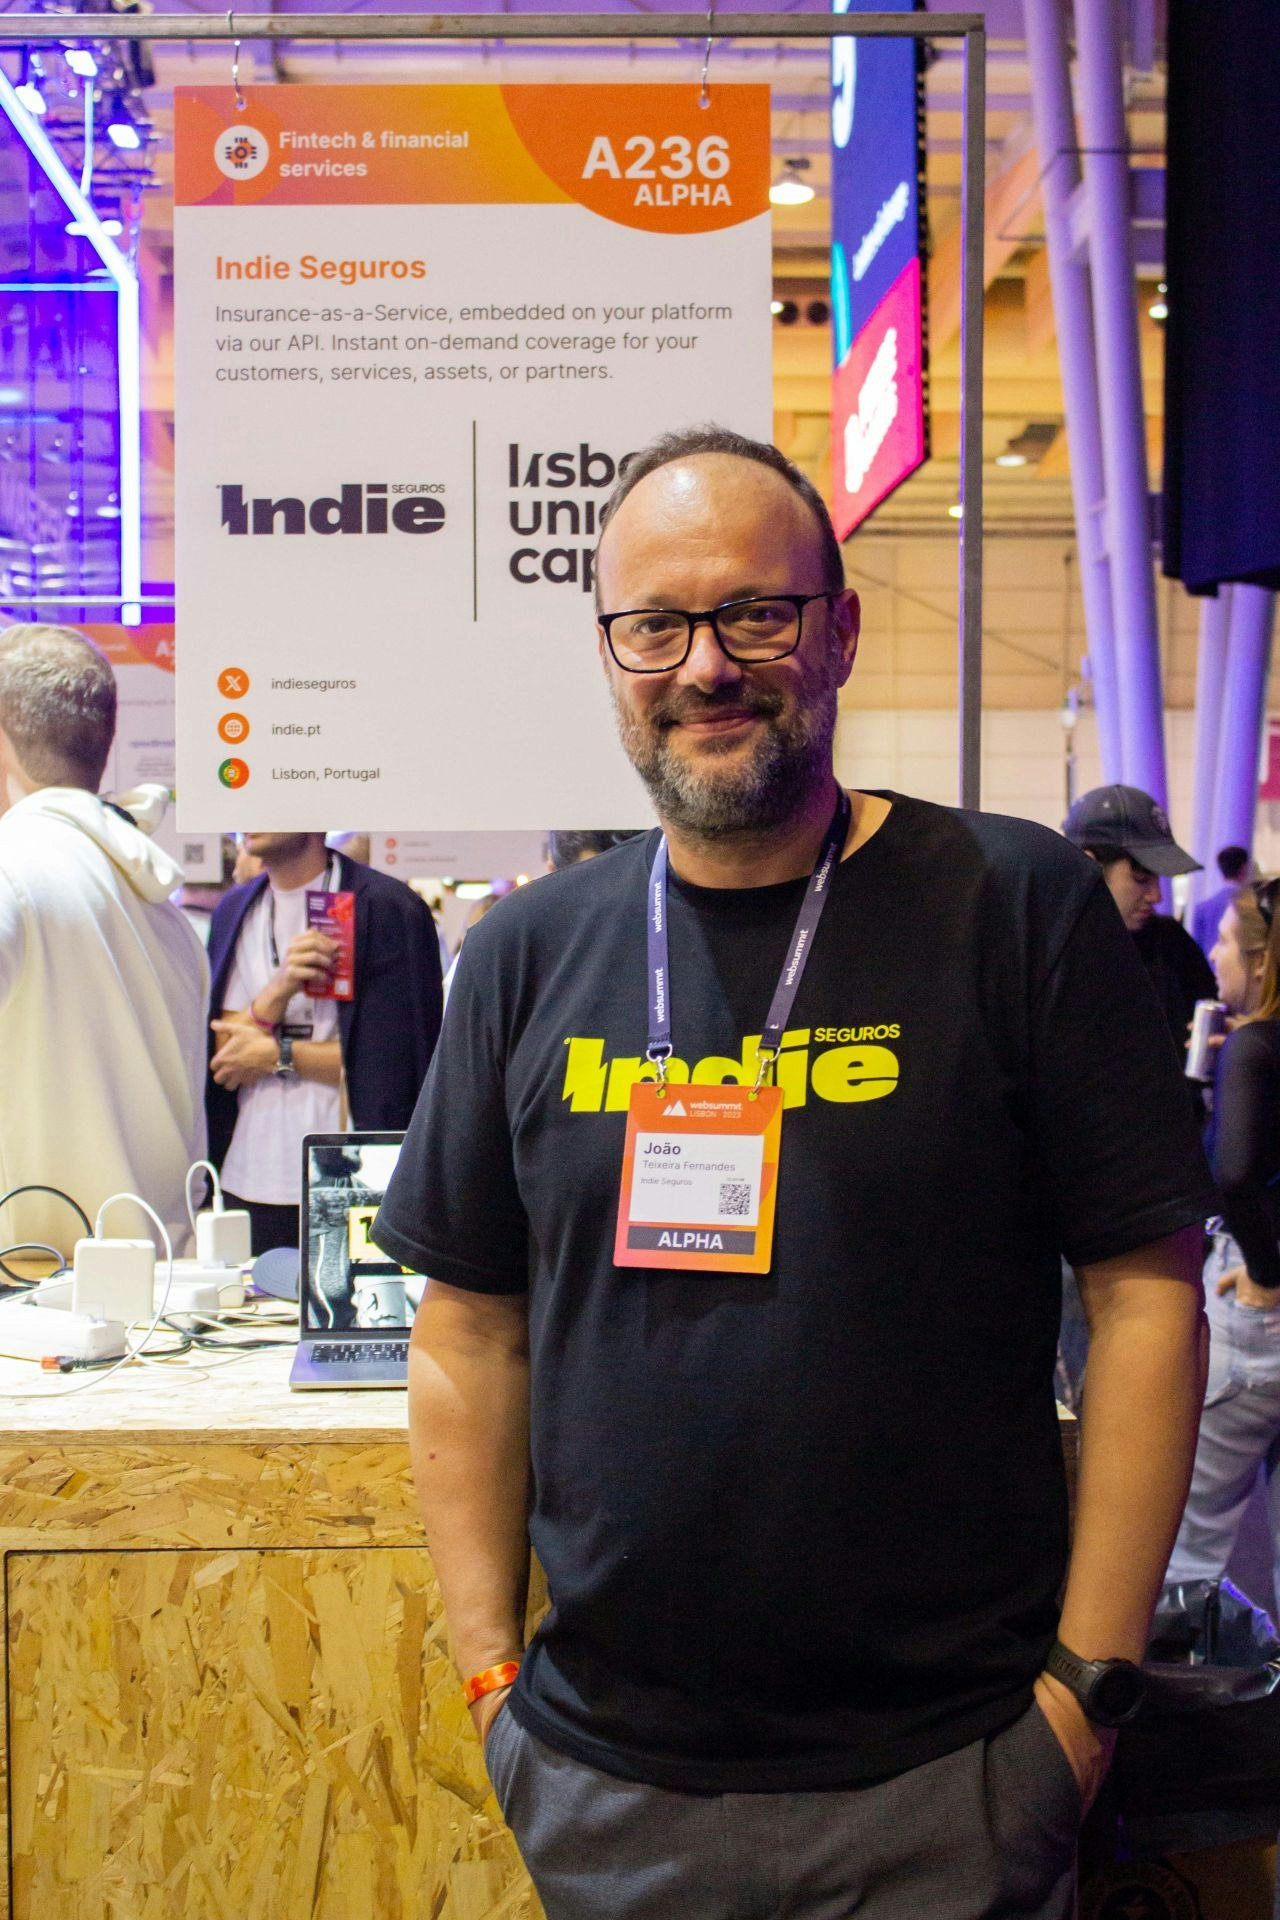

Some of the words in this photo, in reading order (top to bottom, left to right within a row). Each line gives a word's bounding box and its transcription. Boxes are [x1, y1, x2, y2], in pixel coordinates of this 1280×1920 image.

[279, 131, 357, 149] Fintech
[361, 132, 376, 149] &
[380, 130, 469, 149] financial
[581, 135, 731, 180] A236
[279, 159, 368, 178] services
[633, 183, 732, 206] ALPHA
[215, 255, 291, 280] Indie
[299, 254, 427, 286] Seguros
[215, 304, 453, 324] Insurance-as-a-Service,
[459, 304, 565, 321] embedded
[572, 308, 596, 321] on
[602, 307, 646, 323] your
[652, 303, 733, 323] platform
[215, 336, 243, 352] via
[249, 337, 282, 351] our
[287, 335, 325, 350] API.
[331, 335, 398, 350] Instant
[405, 333, 519, 350] on-demand
[525, 335, 617, 353] coverage
[623, 332, 650, 349] for
[656, 335, 699, 353] your
[215, 364, 324, 384] customers,
[330, 363, 417, 383] services,
[423, 363, 493, 382] assets,
[499, 366, 520, 380] or
[526, 363, 614, 382] partners.
[391, 484, 446, 494] SEGUROS
[216, 484, 446, 536] Indie
[509, 500, 612, 536] uni
[271, 678, 357, 692] indieseguros
[271, 723, 321, 738] indie.pt
[271, 767, 320, 781] Lisbon,
[323, 767, 381, 781] Portugal
[652, 881, 663, 934] websummit
[785, 929, 809, 986] websummit
[656, 967, 665, 1024] websummit
[814, 1024, 900, 1043] SEGUROS
[644, 1141, 681, 1155] João
[642, 1159, 681, 1171] Teixeira
[683, 1161, 736, 1172] Fernandes
[640, 1176, 660, 1186] Indie
[661, 1177, 693, 1187] Seguros
[657, 1231, 724, 1250] ALPHA
